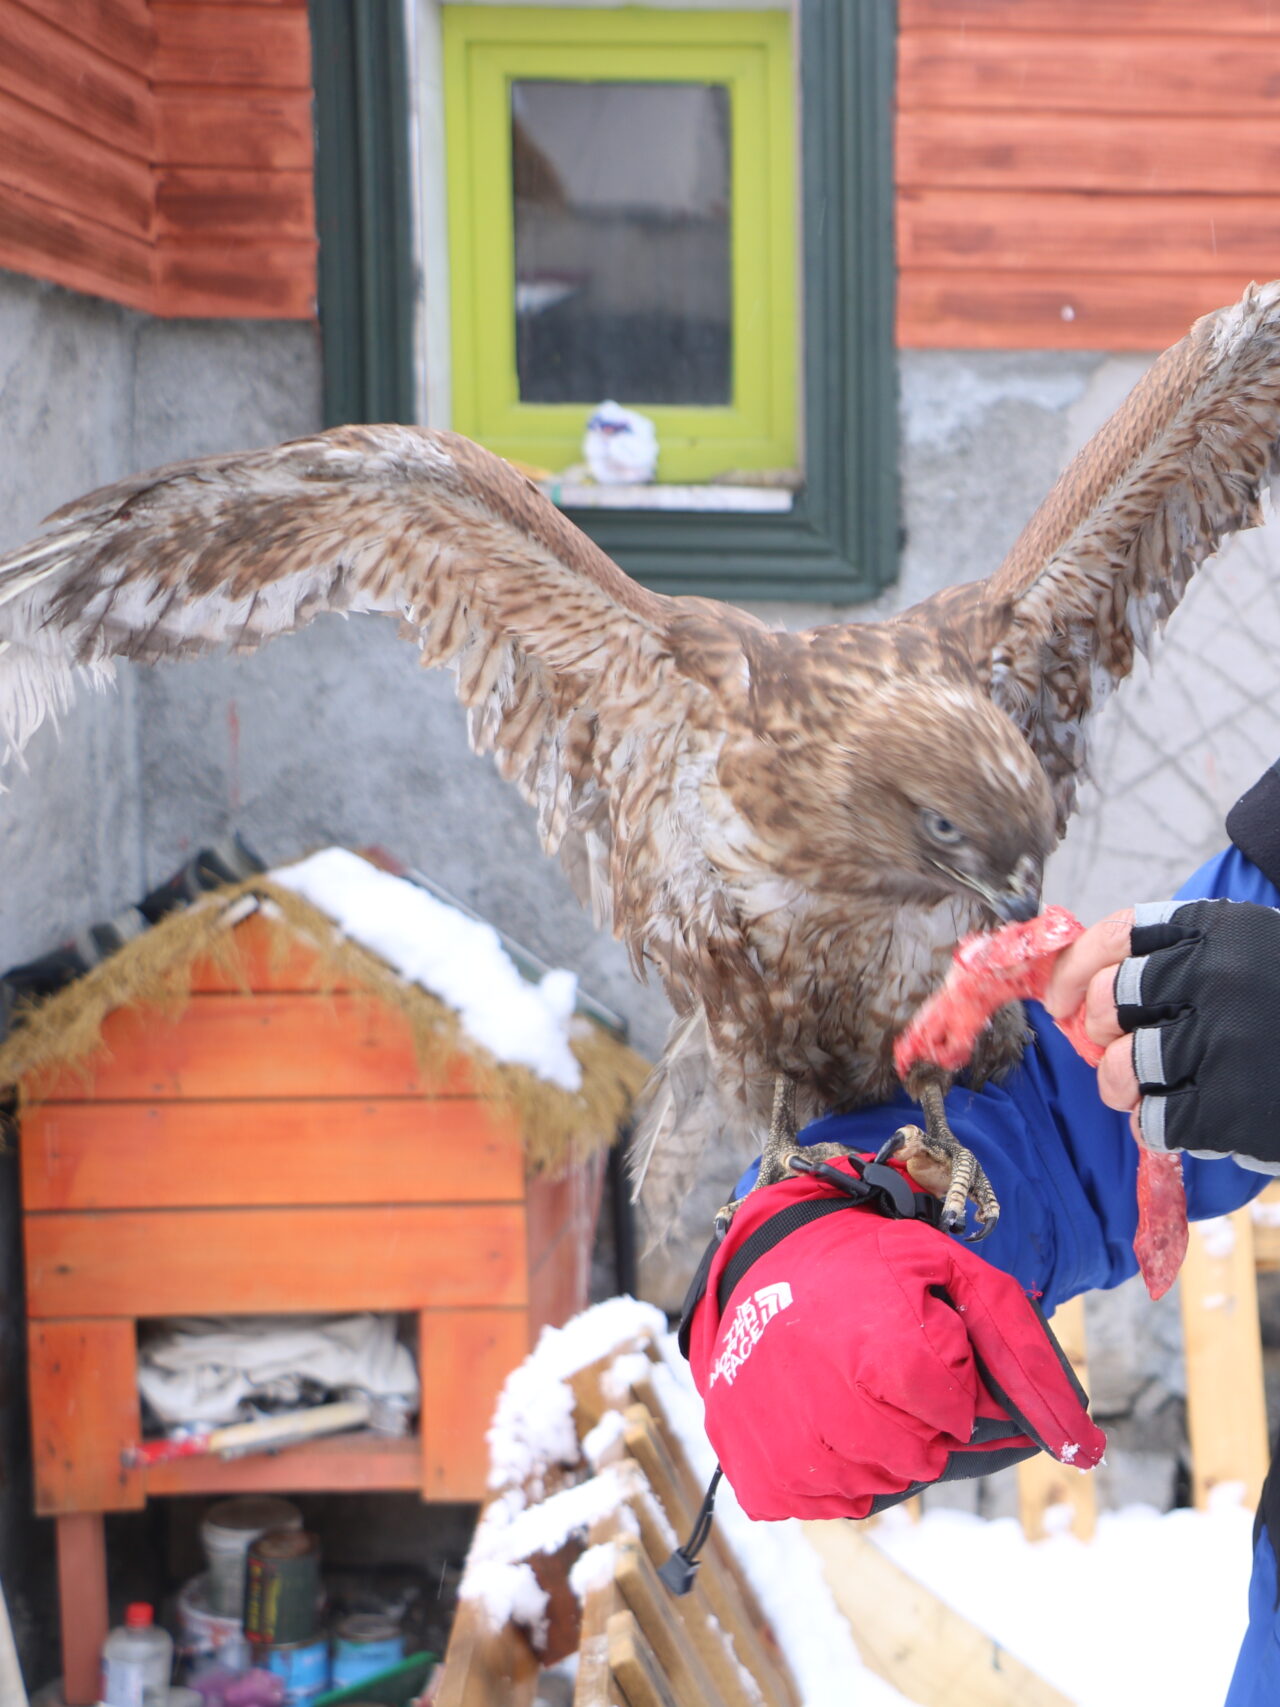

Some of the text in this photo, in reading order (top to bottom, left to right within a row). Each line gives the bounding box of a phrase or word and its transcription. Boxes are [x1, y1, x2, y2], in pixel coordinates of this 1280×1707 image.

[709, 1304, 757, 1388] NORTH
[722, 1296, 753, 1343] THE
[722, 1320, 764, 1386] FACE
